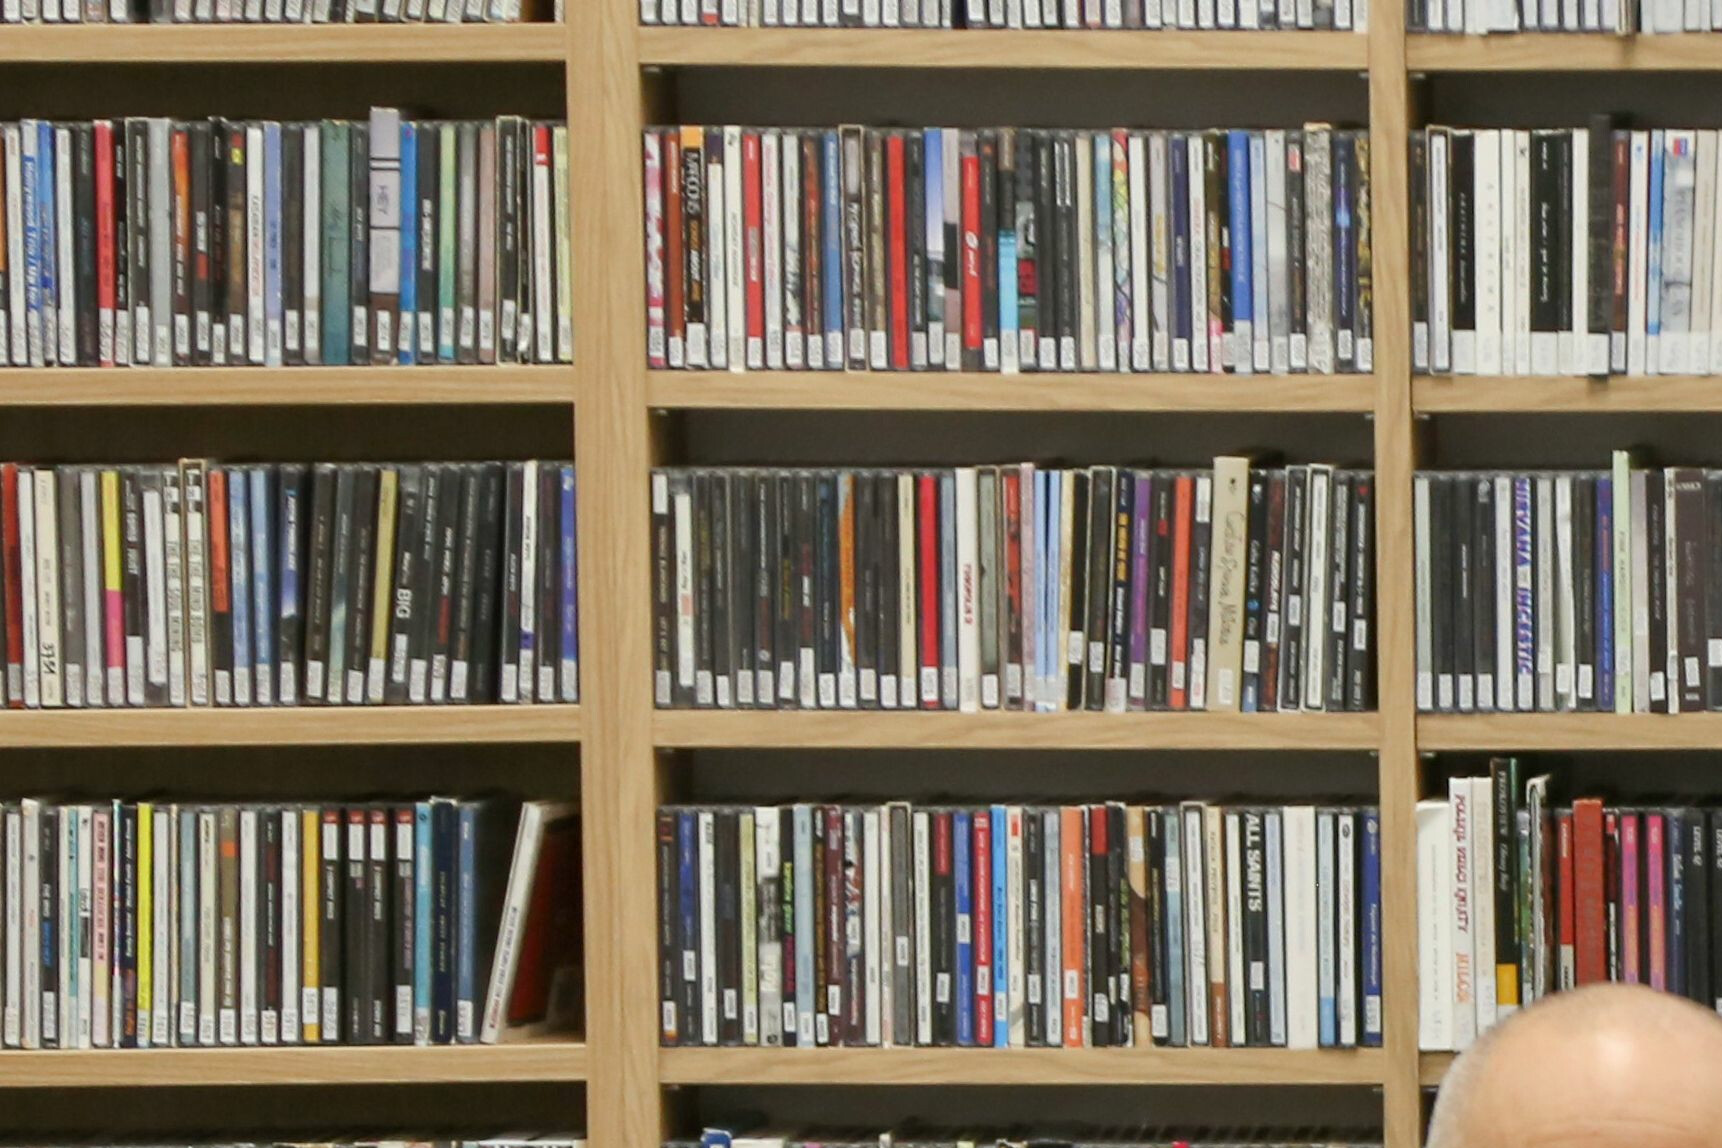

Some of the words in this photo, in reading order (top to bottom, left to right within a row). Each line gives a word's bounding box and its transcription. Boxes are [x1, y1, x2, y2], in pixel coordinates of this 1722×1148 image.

[377, 184, 390, 216] HEY
[396, 588, 412, 619] BIG
[1244, 813, 1260, 847] ALL
[1246, 849, 1262, 912] SAINTS
